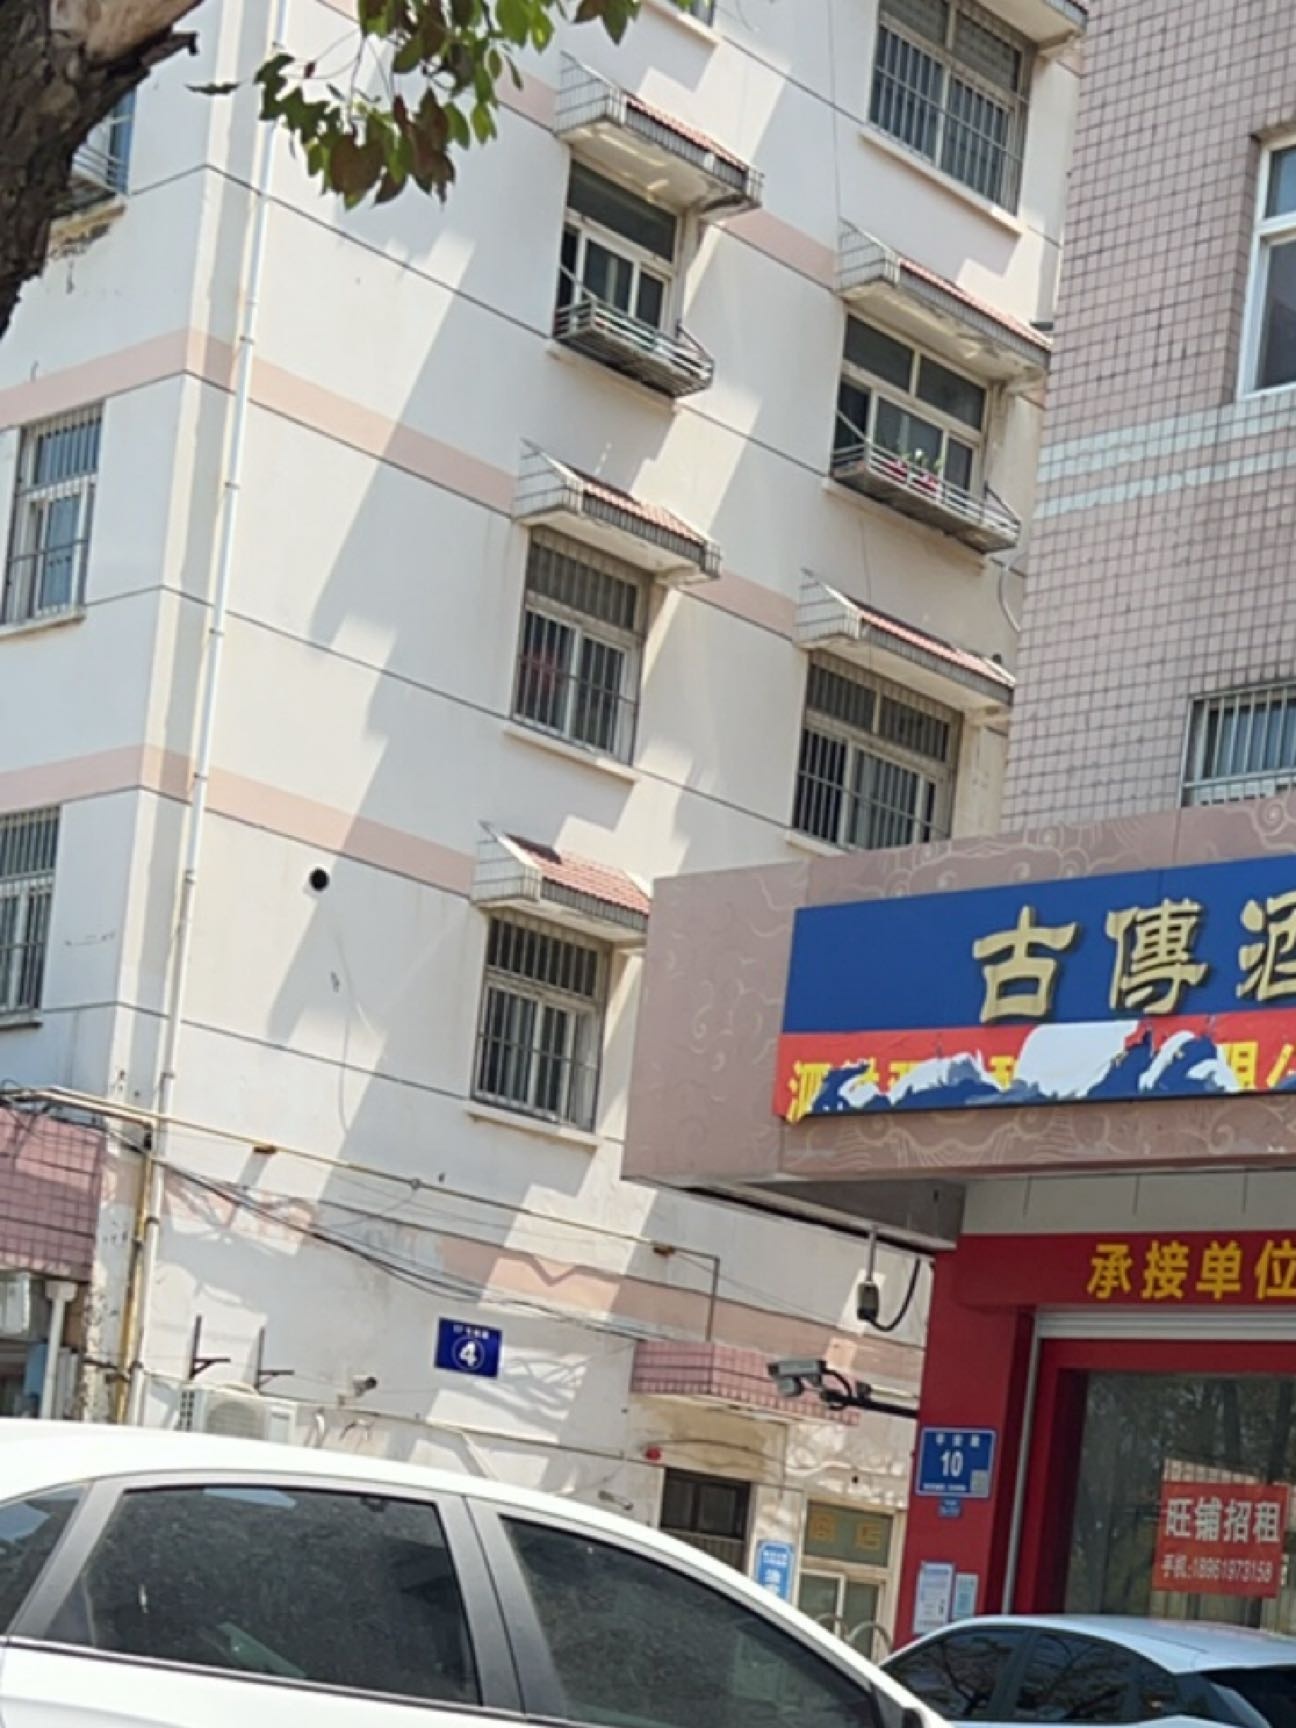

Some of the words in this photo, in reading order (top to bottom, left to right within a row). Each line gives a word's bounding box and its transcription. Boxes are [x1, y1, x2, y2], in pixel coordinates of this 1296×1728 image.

[460, 1341, 477, 1367] 4
[940, 1451, 964, 1478] 10
[1165, 1496, 1281, 1543] 旺铺招租
